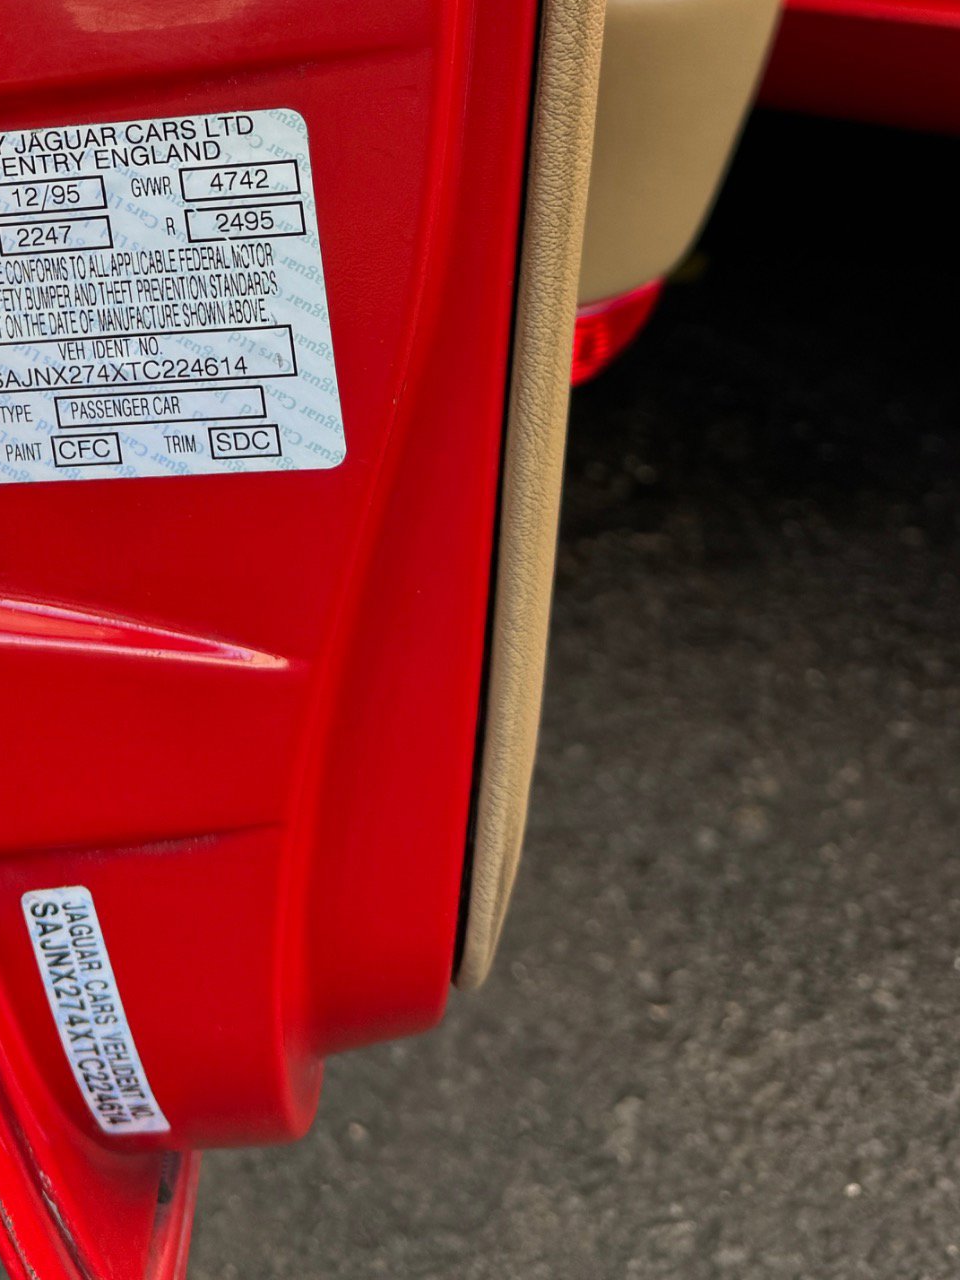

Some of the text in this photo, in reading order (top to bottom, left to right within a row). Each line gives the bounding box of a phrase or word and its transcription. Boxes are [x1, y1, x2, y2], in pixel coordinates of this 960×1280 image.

[14, 127, 118, 154] JAGUAR
[125, 120, 197, 144] CARS
[205, 115, 254, 137] LTD
[95, 140, 221, 170] ENGLAND
[11, 184, 81, 212] 12/95
[131, 169, 270, 198] GVWR 4742
[16, 225, 72, 248] 2247
[165, 210, 275, 236] R 2495
[5, 255, 69, 285] CONFORMS
[69, 255, 87, 280] TO
[89, 254, 110, 278] ALL
[111, 249, 178, 277] APPLICABLE
[178, 245, 231, 272] FEDERAL
[26, 284, 74, 311] BUMPER
[74, 281, 97, 308] AND
[98, 279, 134, 305] THEFT
[136, 275, 208, 303] PREVENTION
[209, 270, 278, 299] STANDARDS
[5, 314, 23, 339] ON
[23, 312, 48, 337] THE
[48, 310, 78, 336] DATE
[79, 309, 94, 334] OF
[97, 303, 182, 332] MANUFACTURE
[182, 300, 227, 327] SHOWN
[57, 341, 86, 362] VEH
[92, 338, 131, 360] IDENT
[139, 336, 163, 357] NO.
[0, 395, 181, 423] TYPE PASSENGER CAR
[5, 438, 111, 462] PAINT CFC
[163, 430, 270, 454] TRIM SDC
[61, 901, 103, 973] JAGUAR
[83, 978, 118, 1026] CARS
[30, 901, 132, 1126] SAJNX274XTC224614
